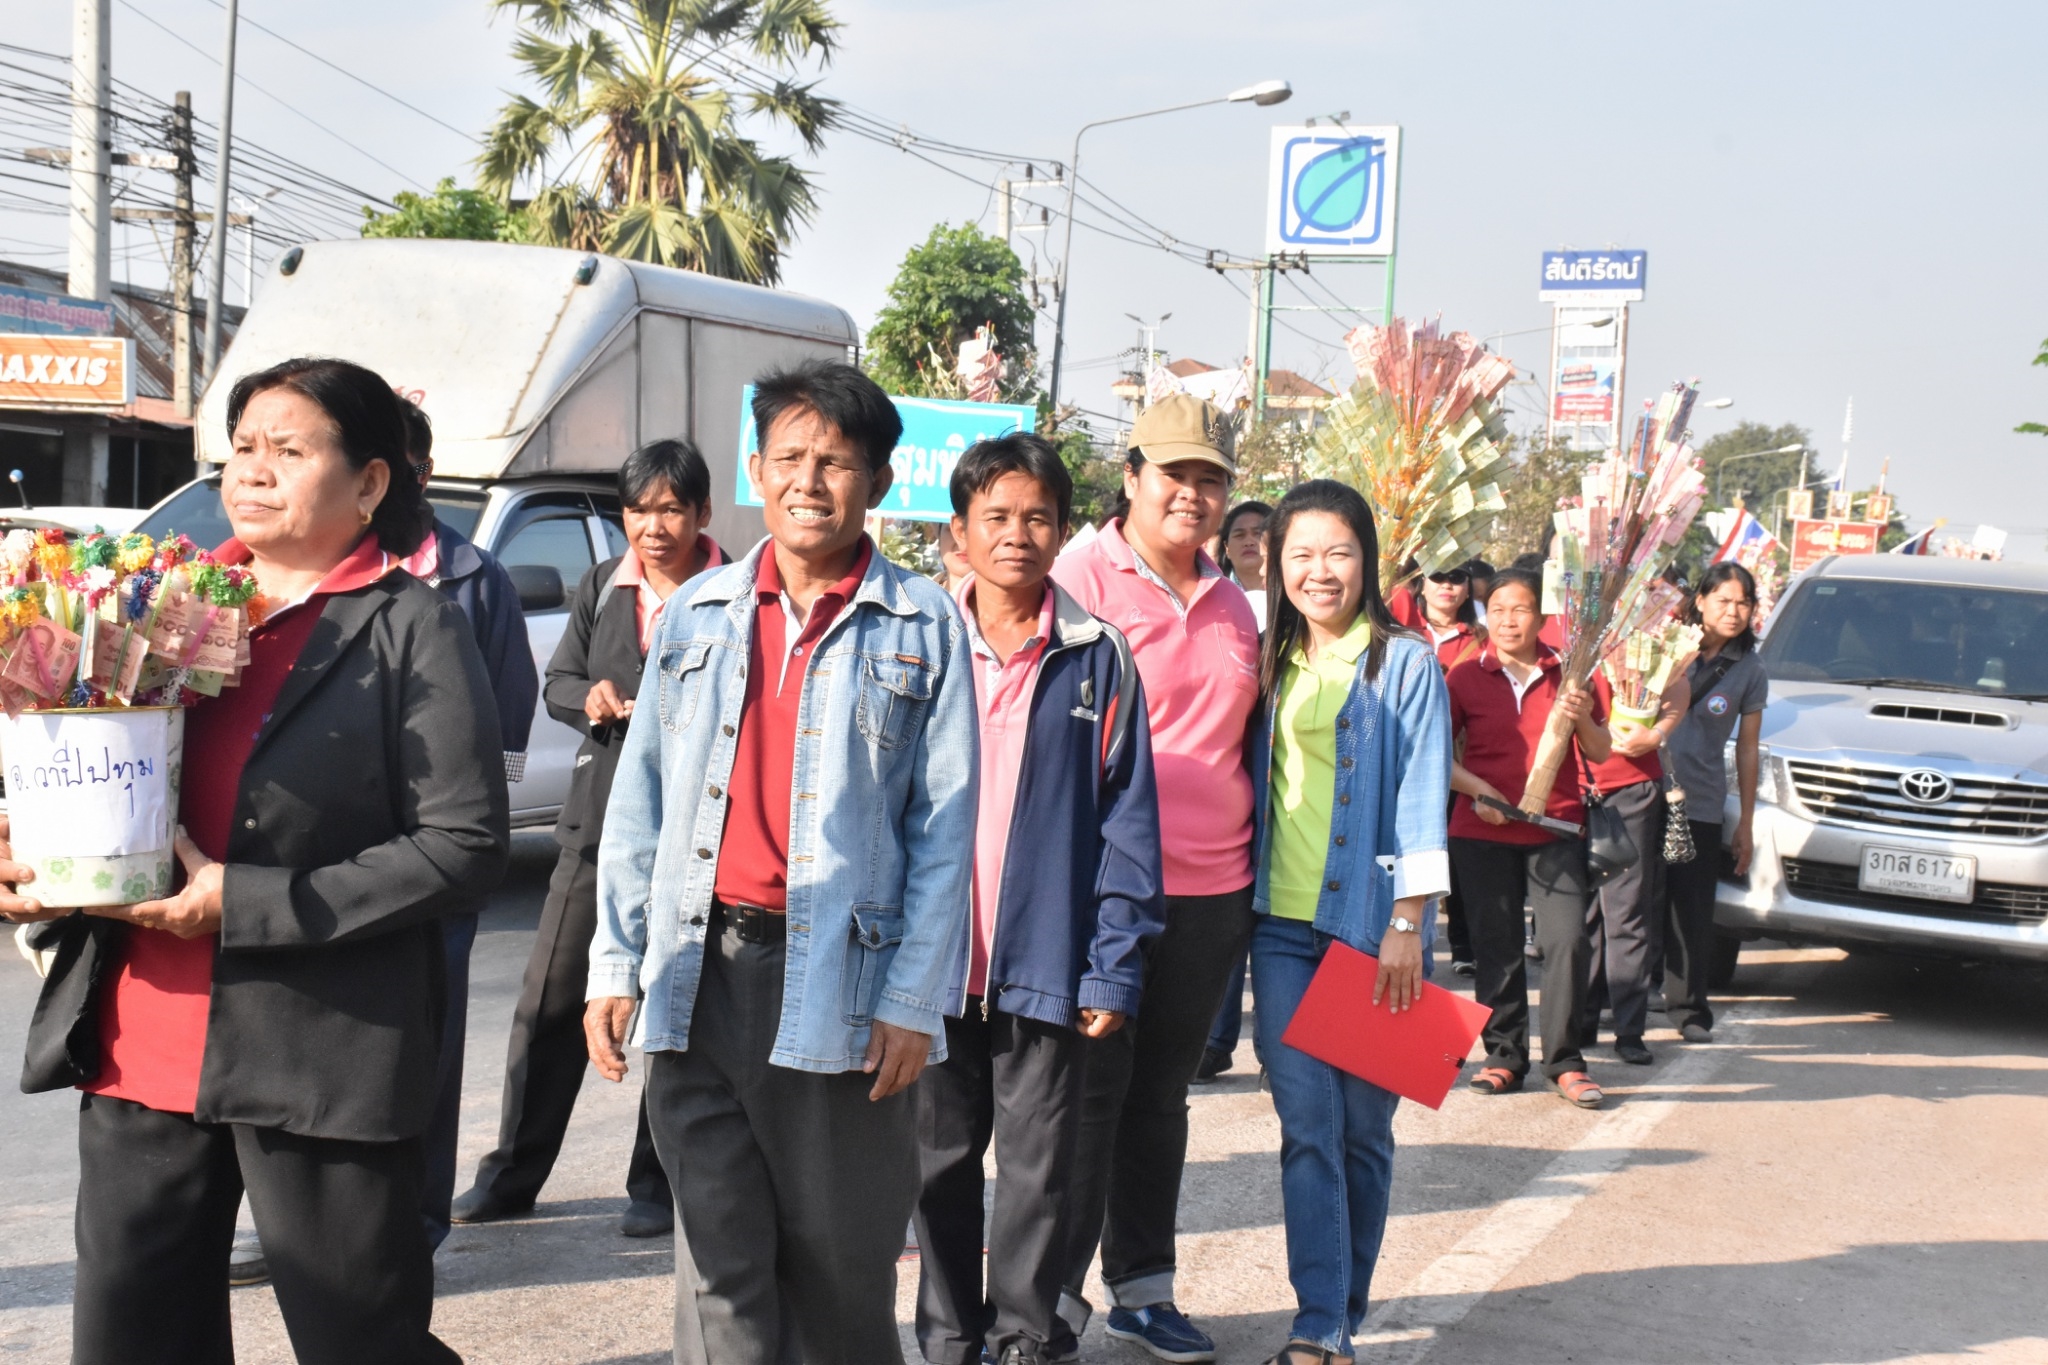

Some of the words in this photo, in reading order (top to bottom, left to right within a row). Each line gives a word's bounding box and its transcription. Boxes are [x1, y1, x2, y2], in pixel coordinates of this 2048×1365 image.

[1545, 256, 1642, 281] สันติรัตน์
[0, 353, 109, 386] AXXIS
[1869, 852, 1912, 875] 3กส
[1916, 858, 1966, 881] 6170
